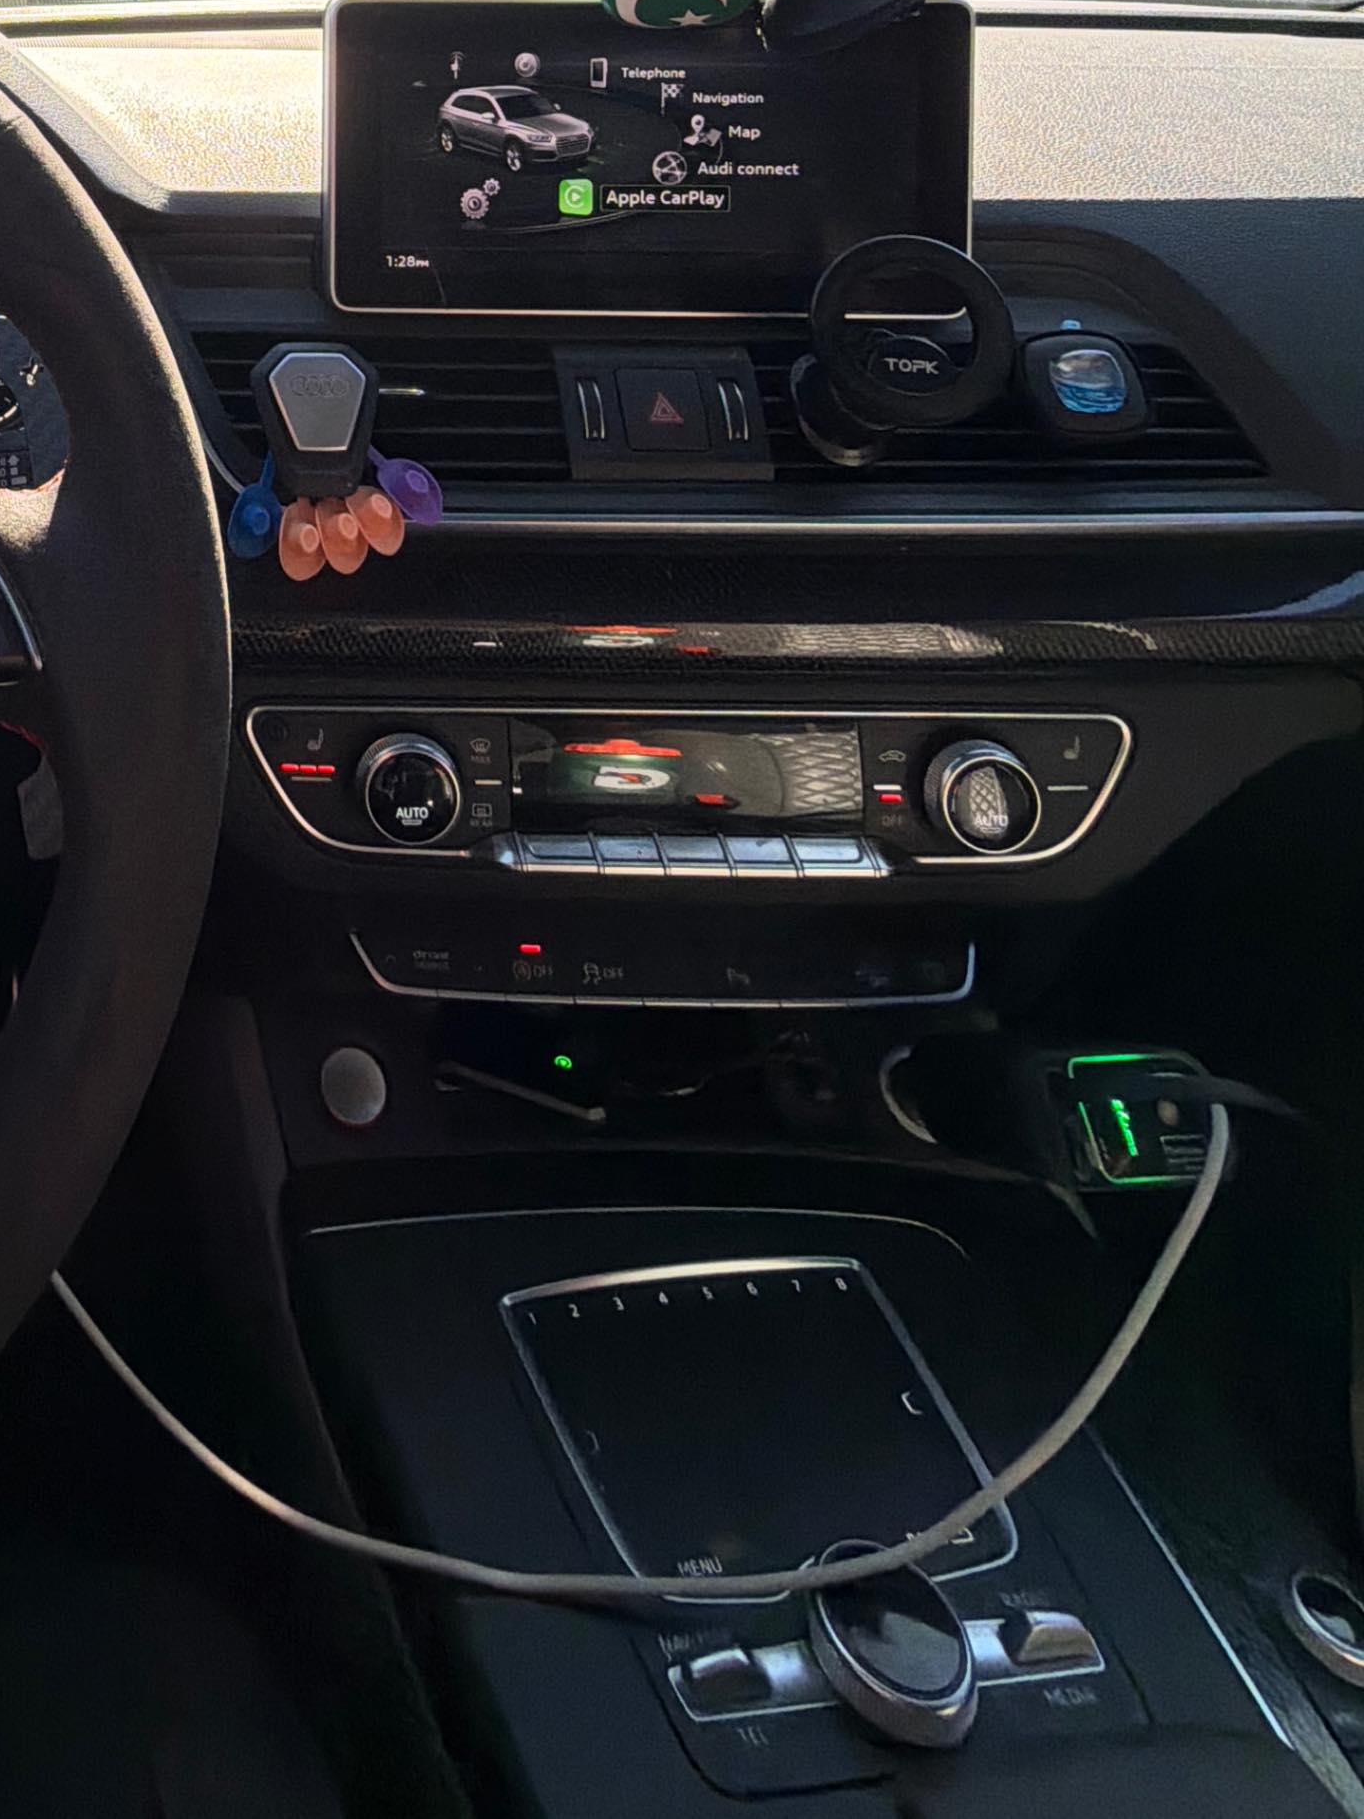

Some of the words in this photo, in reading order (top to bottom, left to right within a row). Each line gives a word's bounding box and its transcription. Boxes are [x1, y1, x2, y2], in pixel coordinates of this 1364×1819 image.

[621, 67, 686, 81] Telephone
[692, 91, 764, 107] Navigation
[728, 125, 761, 142] Map
[697, 161, 733, 175] Audi
[737, 162, 799, 176] connect
[606, 189, 656, 210] Apple
[660, 189, 725, 210] CarPlay
[885, 357, 939, 375] TOPK
[395, 806, 429, 819] AUTO
[975, 814, 1008, 827] AUTO
[569, 1303, 580, 1318] 2
[746, 1282, 758, 1296] 6
[791, 1280, 801, 1292] 7
[836, 1277, 847, 1291] 8
[677, 1555, 723, 1576] MENU
